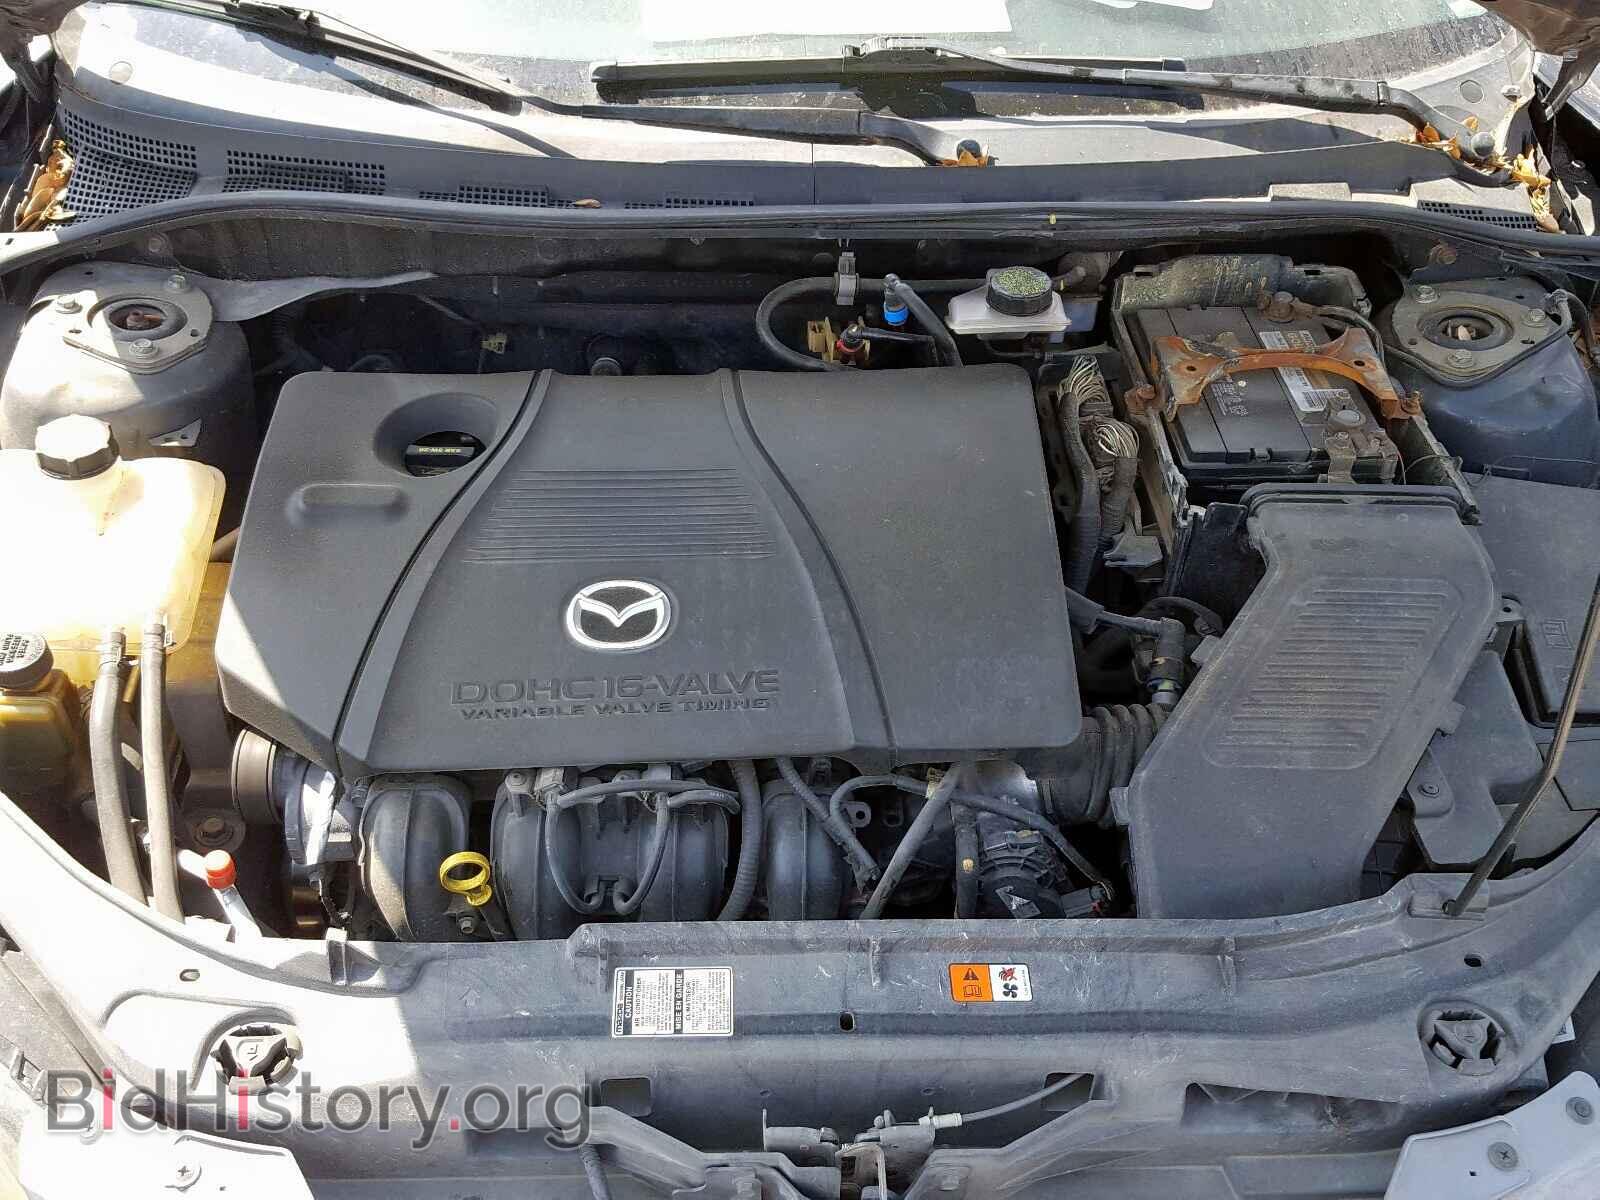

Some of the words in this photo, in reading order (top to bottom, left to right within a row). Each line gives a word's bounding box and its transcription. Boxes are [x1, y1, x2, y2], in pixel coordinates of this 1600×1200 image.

[451, 677, 595, 704] DOHC
[602, 669, 779, 698] 16-VALVE
[461, 704, 585, 720] VARIABLE
[593, 701, 673, 717] VALVE
[678, 698, 769, 712] TIMING
[675, 973, 683, 999] GARDE
[625, 986, 633, 1018] CAUTION
[675, 1000, 683, 1010] EN
[675, 1012, 683, 1030] MISE
